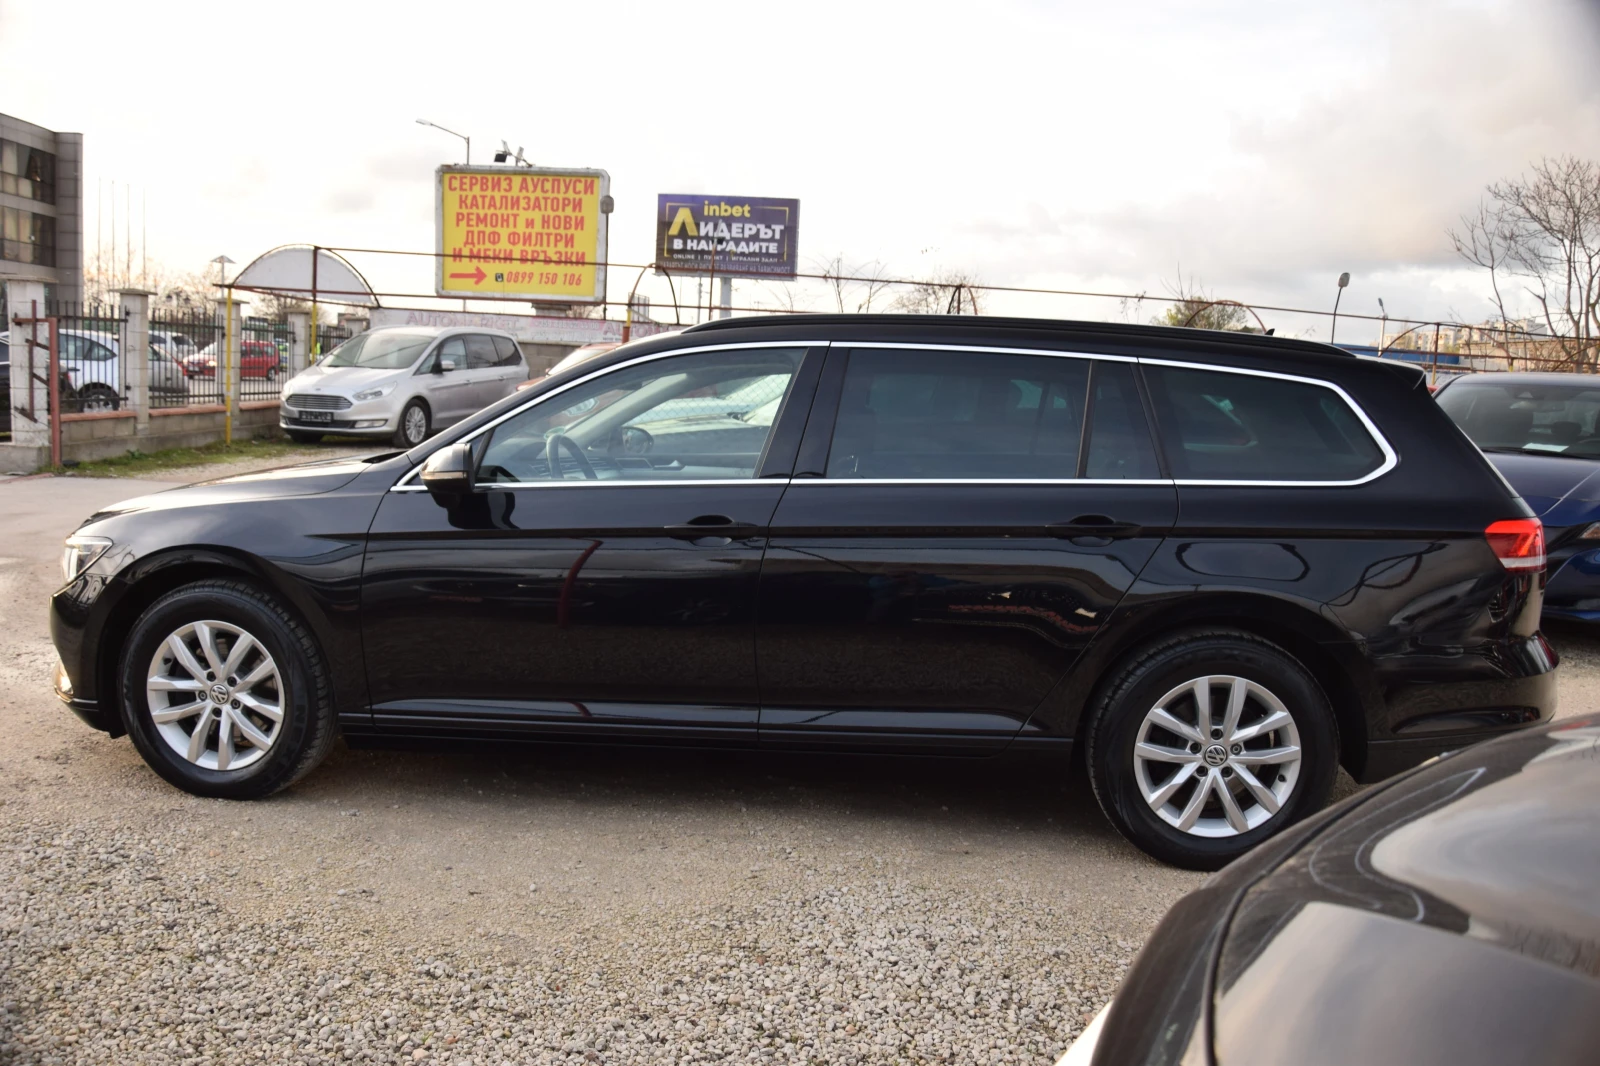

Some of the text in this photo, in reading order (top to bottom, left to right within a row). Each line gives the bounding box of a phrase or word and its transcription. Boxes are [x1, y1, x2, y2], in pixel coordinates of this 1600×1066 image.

[448, 175, 595, 195] СЕРВИЗ АУСПУСИ
[458, 194, 583, 213] КАТАЛИЗАТОРИ
[703, 200, 751, 218] inbet
[456, 212, 585, 231] РЕМОНТ и НОВИ
[463, 230, 575, 248] ДПФ ФИЛТРИ
[673, 238, 683, 250] В
[452, 247, 586, 267] И МЕКИ ВРЪЗКИ
[506, 271, 582, 286] 0899 150 106
